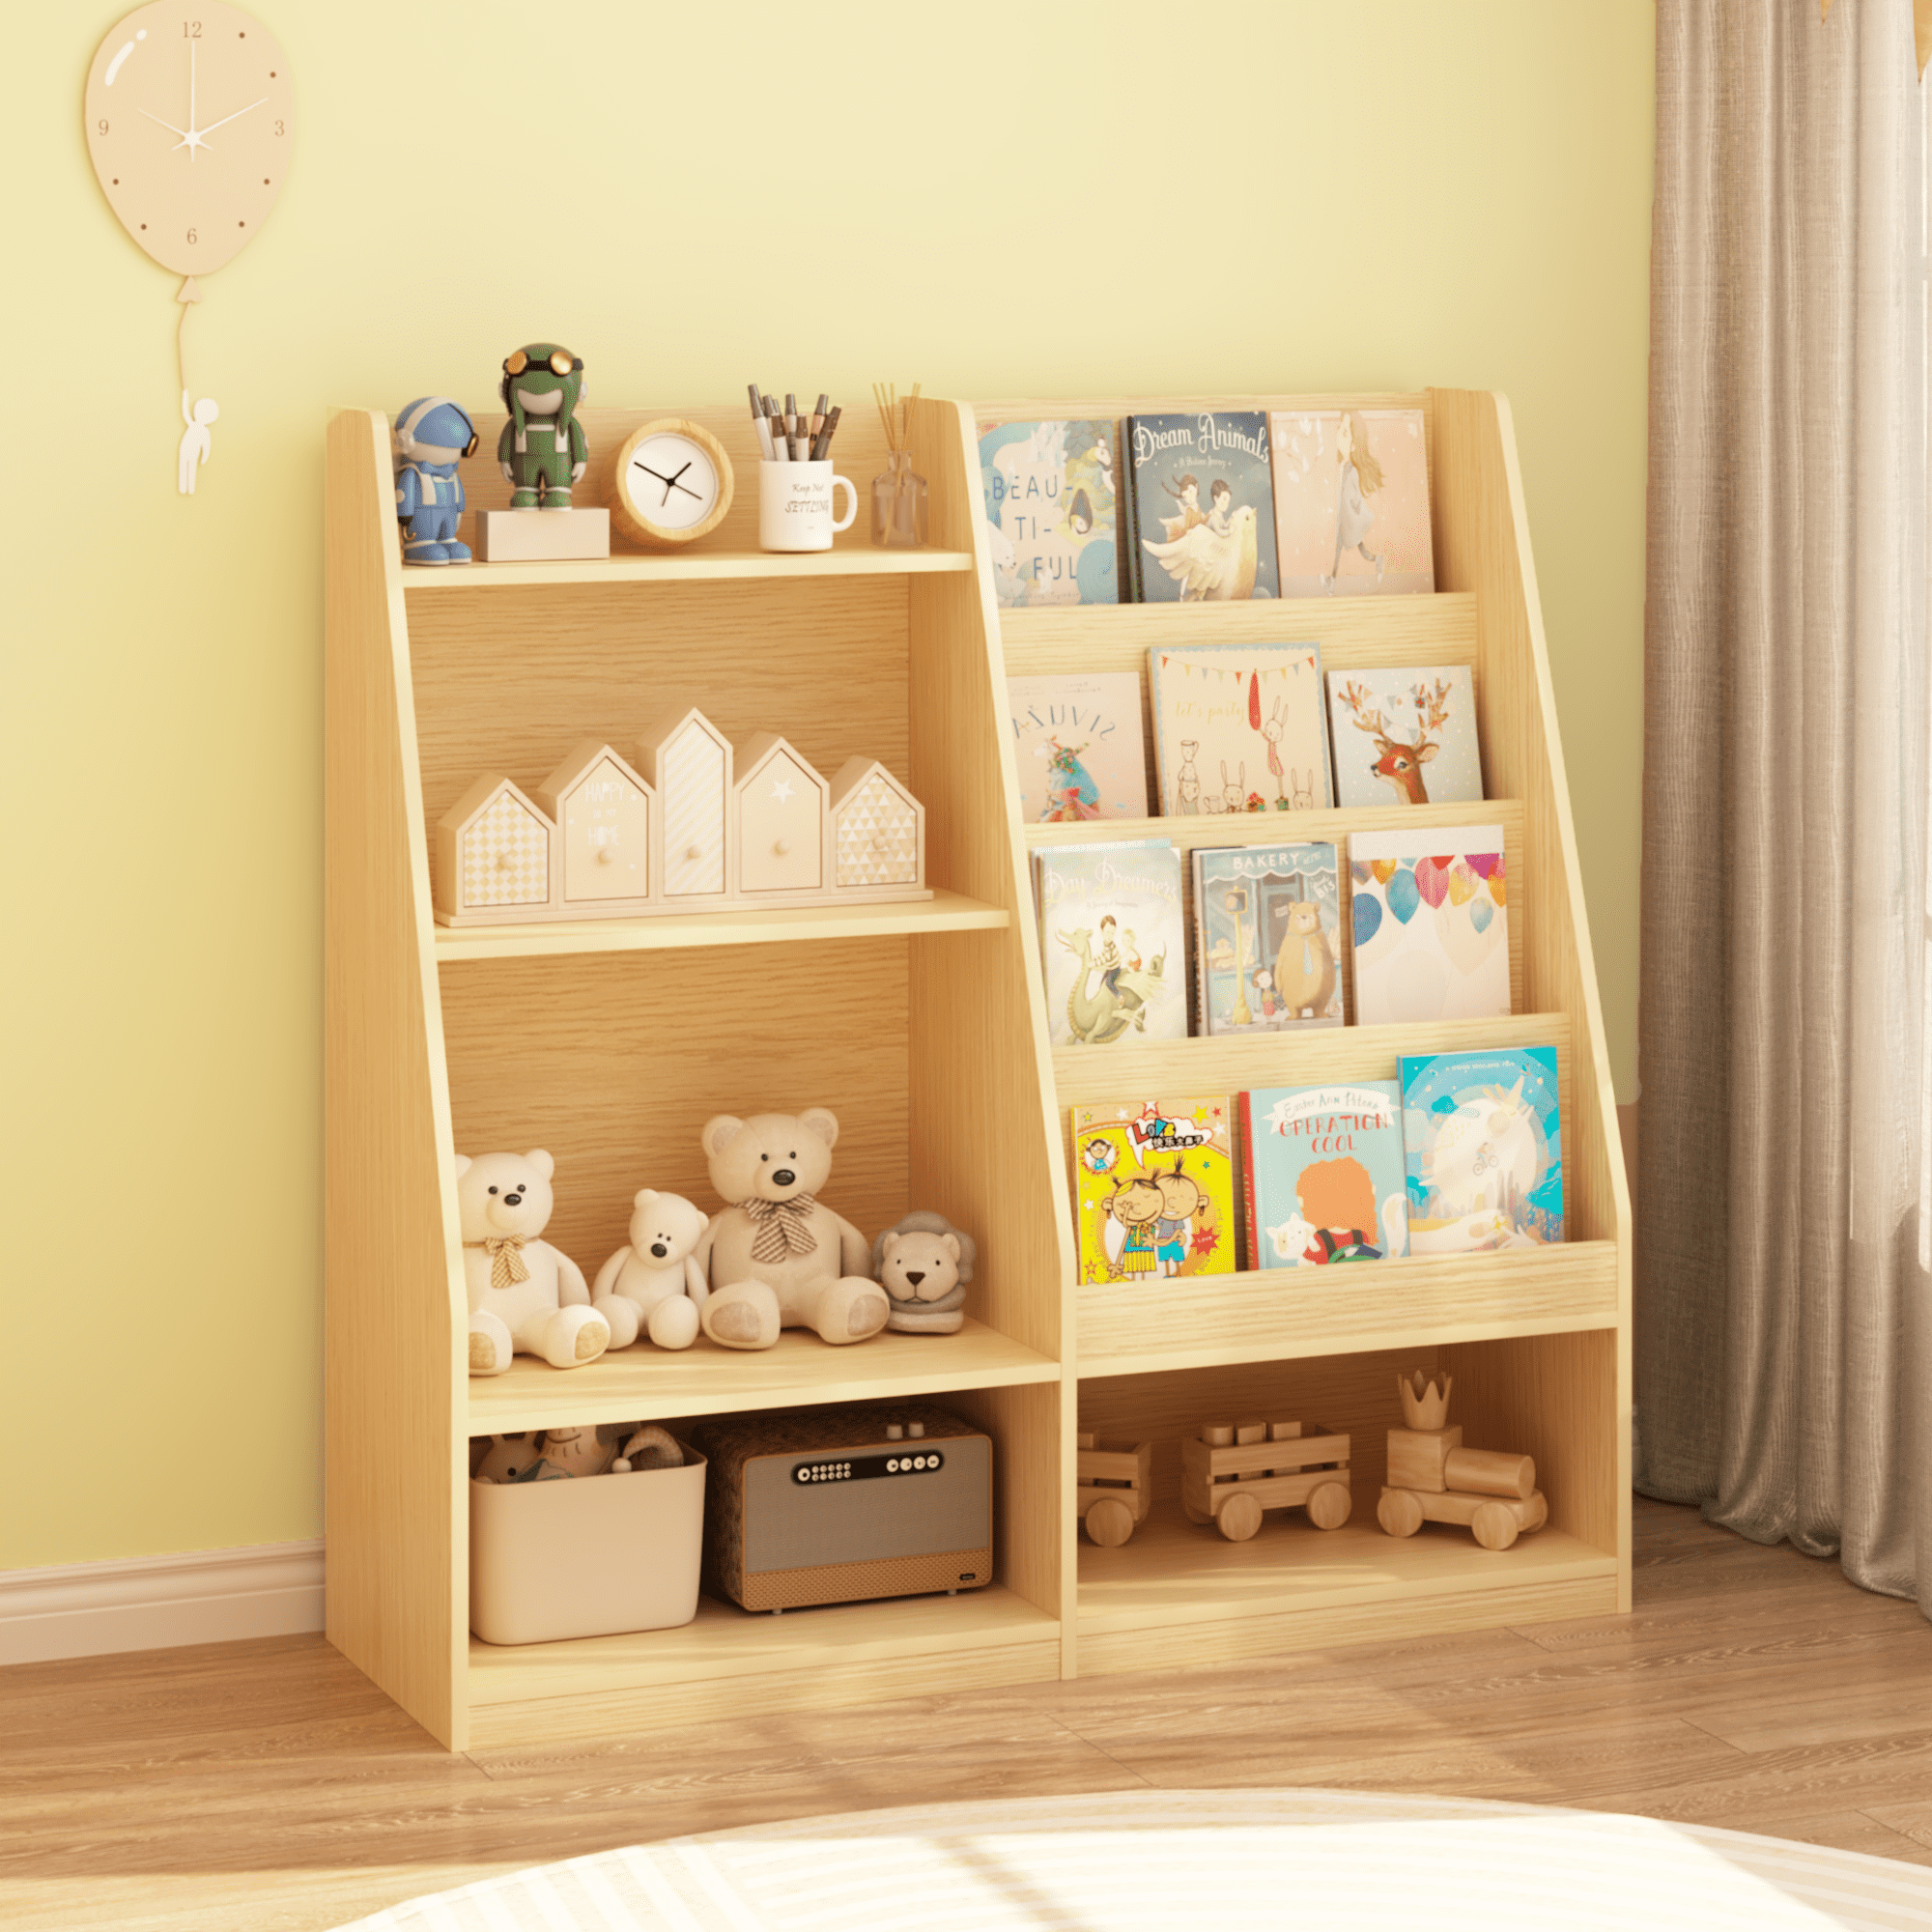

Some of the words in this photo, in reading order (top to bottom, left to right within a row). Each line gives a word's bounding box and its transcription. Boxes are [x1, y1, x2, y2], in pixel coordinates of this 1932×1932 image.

[184, 21, 202, 39] 12
[99, 119, 109, 136] 9
[275, 120, 285, 137] 3
[186, 228, 197, 245] 6
[1133, 421, 1195, 469] Dream
[1198, 412, 1269, 464] Animals
[784, 499, 829, 514] SETTLING
[1034, 556, 1076, 581] FUL
[585, 781, 626, 803] HAPPY
[588, 824, 620, 846] HOME
[1233, 852, 1300, 870] BAKERY
[1279, 1113, 1389, 1137] OPERATION
[1311, 1134, 1358, 1154] COOL
